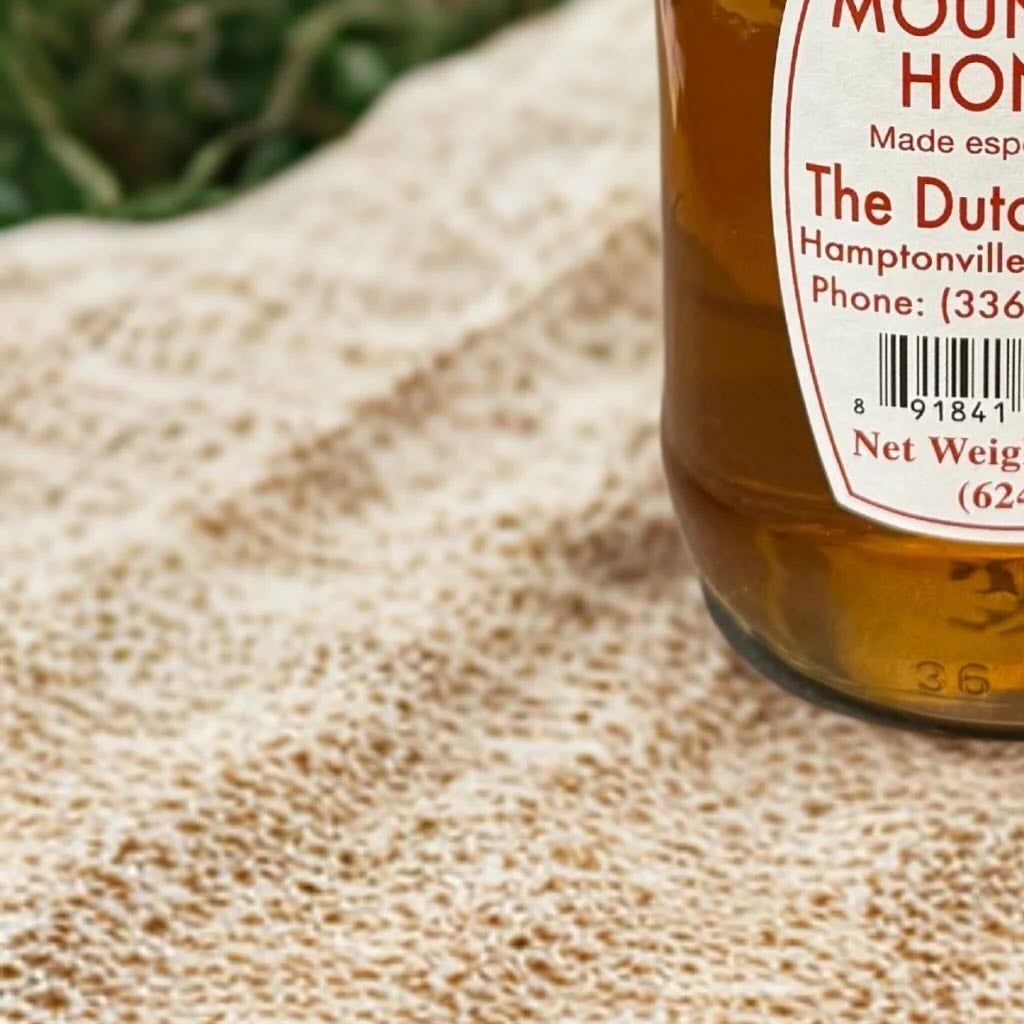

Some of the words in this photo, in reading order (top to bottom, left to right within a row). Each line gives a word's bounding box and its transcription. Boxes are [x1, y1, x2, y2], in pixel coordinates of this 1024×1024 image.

[870, 125, 954, 153] Made
[806, 163, 892, 225] The
[812, 276, 924, 316] Phone:
[853, 398, 865, 415] 8
[910, 399, 1006, 423] 91841
[853, 429, 915, 462] Net
